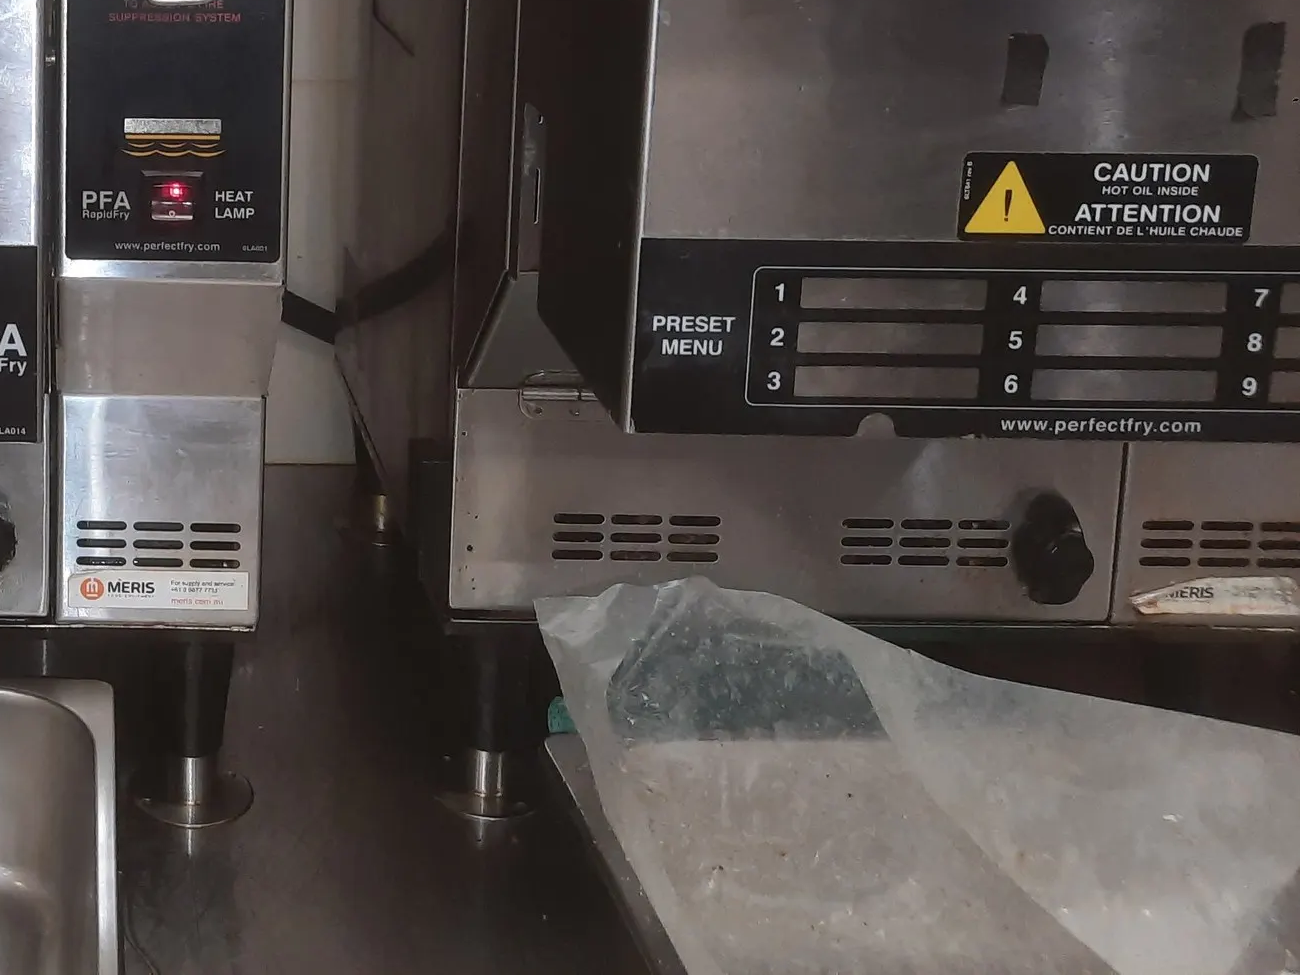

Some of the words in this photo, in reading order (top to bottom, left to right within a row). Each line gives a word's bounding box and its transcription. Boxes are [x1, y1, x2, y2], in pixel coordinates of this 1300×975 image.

[108, 13, 191, 22] SUPPRESSION
[195, 13, 241, 23] SYSTEM
[1093, 162, 1210, 183] CAUTION
[82, 190, 131, 210] PFA
[215, 191, 254, 203] HEAT
[1101, 185, 1127, 196] HOT
[1132, 185, 1153, 196] OIL
[1157, 186, 1199, 196] INSIDE
[82, 209, 130, 221] RapidFry
[214, 207, 255, 219] LAMP
[1074, 203, 1221, 223] ATTENTION
[1048, 224, 1111, 236] CONTIENT
[1116, 225, 1134, 236] DE
[1137, 226, 1186, 236] L'HUILE
[1190, 226, 1244, 237] CHAUDE
[114, 241, 221, 253] www.perfectfry.com
[774, 282, 785, 302] 1
[1012, 286, 1028, 305] 4
[1254, 288, 1270, 307] 7
[652, 315, 736, 333] PRESET
[770, 328, 784, 346] 2
[1008, 331, 1023, 350] 5
[1247, 333, 1263, 352] 8
[661, 339, 723, 356] MENU
[766, 371, 781, 390] 3
[1003, 375, 1019, 394] 6
[1241, 377, 1258, 396] 9
[1000, 417, 1202, 436] www.perfectfry.com
[107, 581, 156, 594] MERIS
